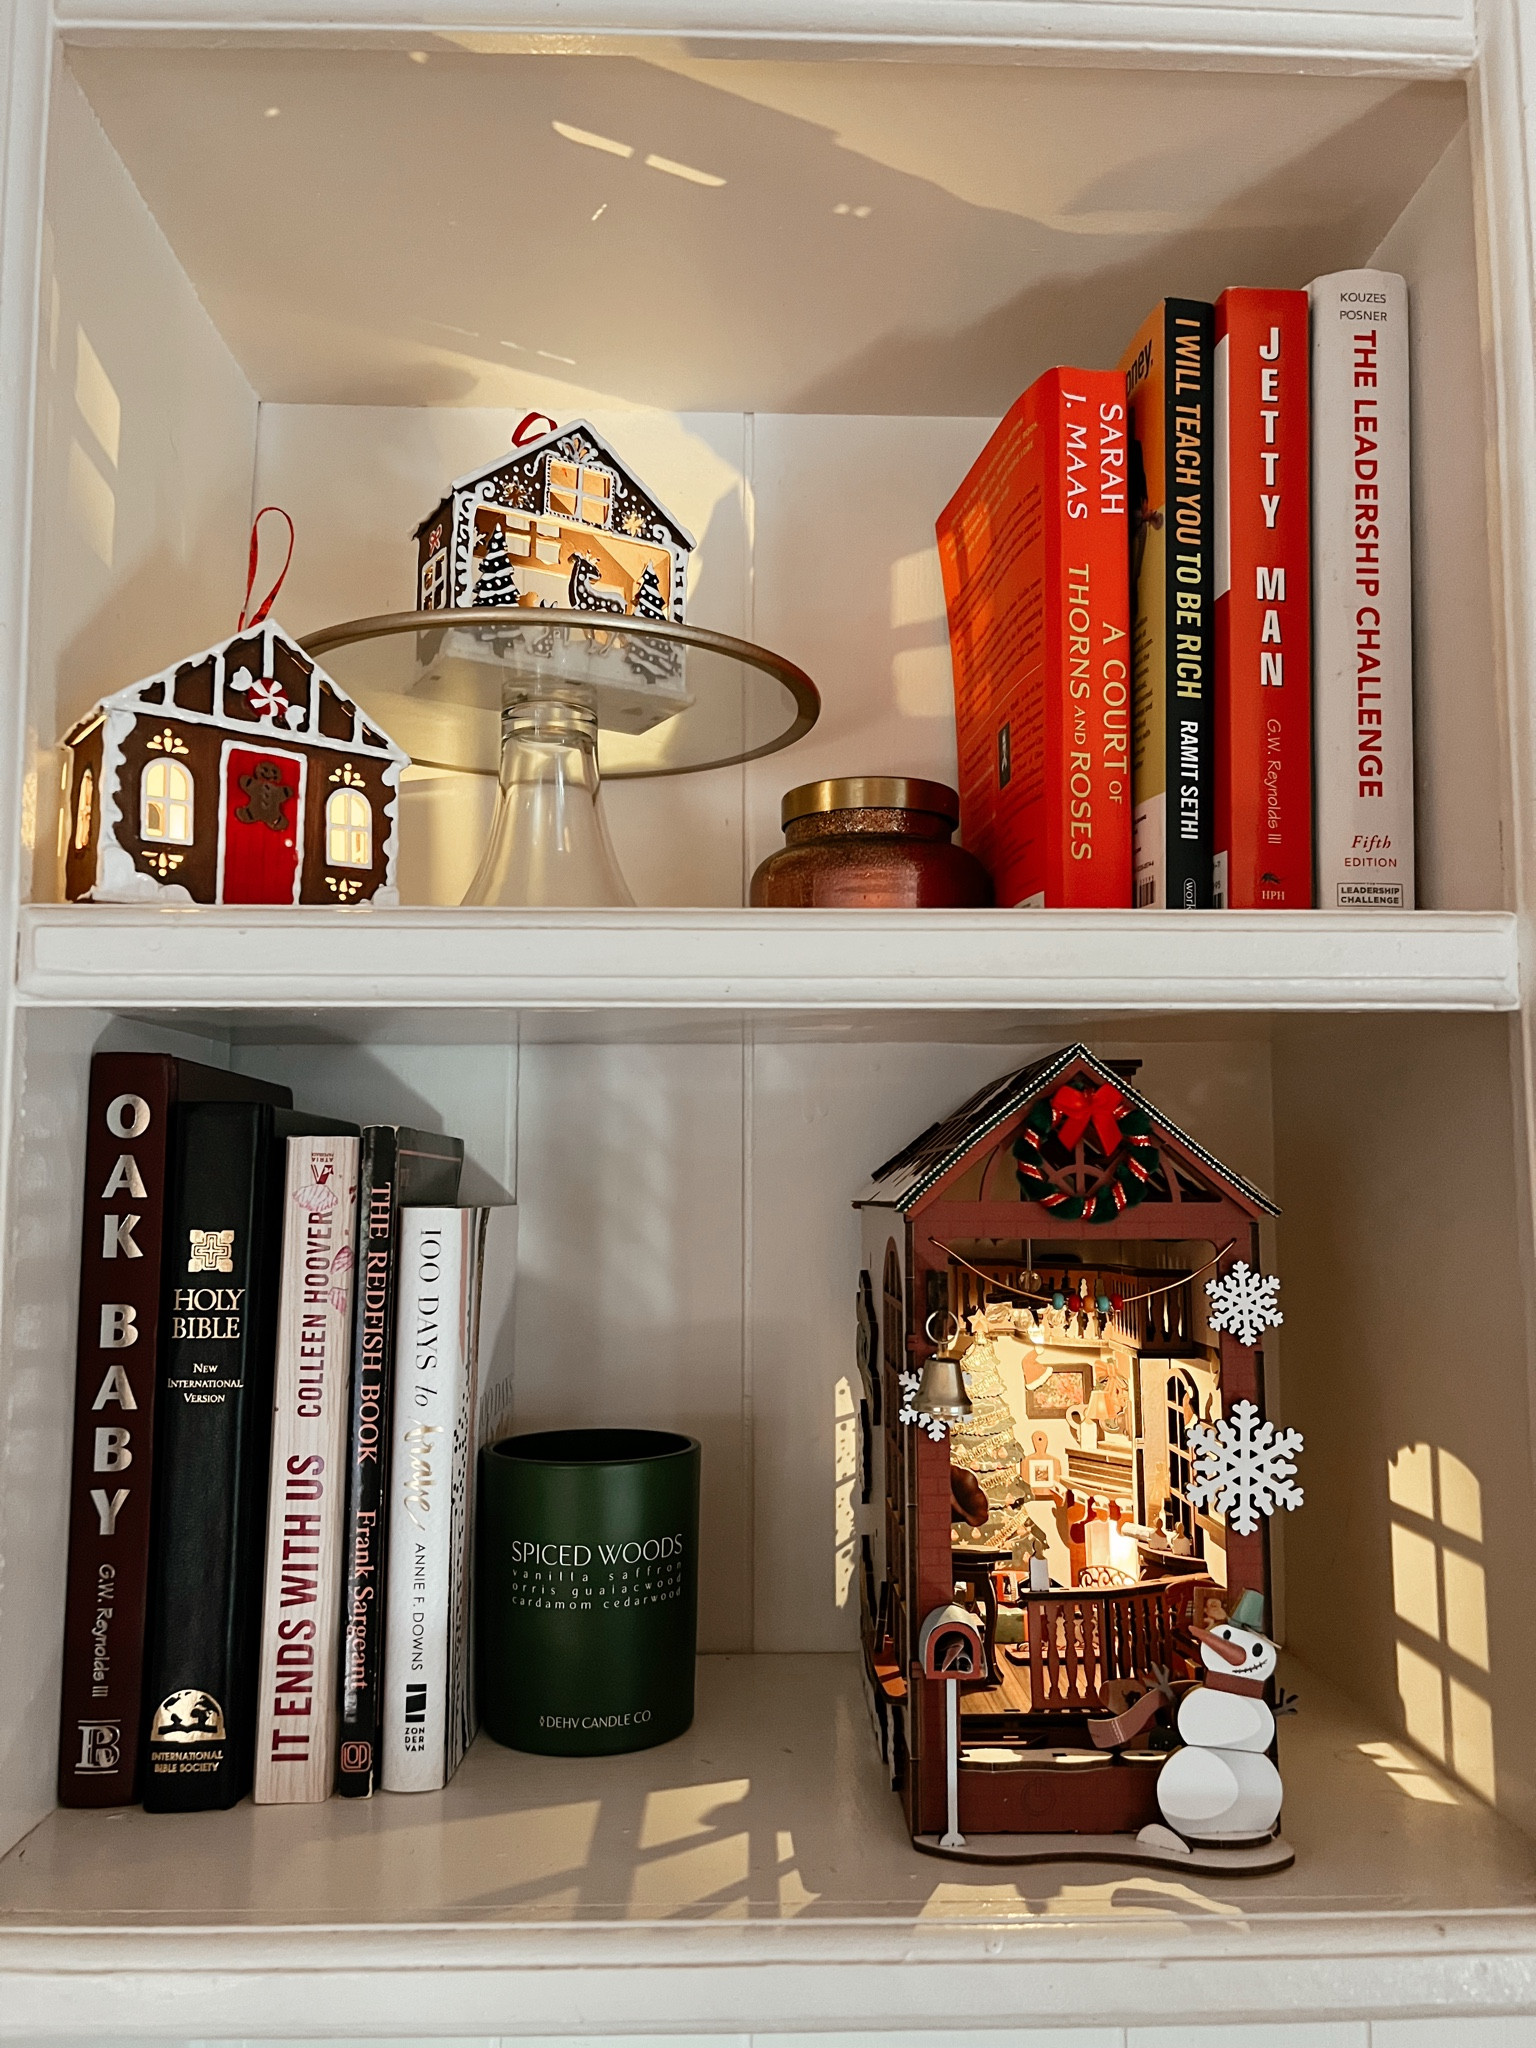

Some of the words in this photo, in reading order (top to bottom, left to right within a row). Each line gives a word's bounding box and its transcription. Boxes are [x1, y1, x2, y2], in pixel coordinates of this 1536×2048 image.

[1339, 310, 1388, 322] POSNER
[1340, 292, 1387, 304] KOUZES
[1175, 318, 1201, 328] I
[1175, 335, 1201, 395] WILL
[1353, 329, 1377, 388] THE
[1061, 389, 1088, 409] J.
[1175, 404, 1201, 485] TEACH
[1259, 326, 1281, 529] JETTY
[1066, 422, 1088, 519] MAAS
[1099, 403, 1125, 514] SARAH
[1175, 493, 1202, 545] YOU
[1354, 399, 1380, 598] LEADERSHIP
[1176, 553, 1202, 584] TO
[1068, 563, 1091, 699] THORNS
[1176, 591, 1202, 627] BE
[1256, 566, 1285, 688] MAN
[1102, 621, 1127, 645] A
[1176, 634, 1203, 699] RICH
[1073, 705, 1086, 745] AND
[1103, 659, 1127, 775] COURT
[1356, 606, 1383, 798] CHALLENGE
[1180, 720, 1199, 781] RAMIT
[1266, 718, 1281, 755] G.W.
[1070, 751, 1092, 860] ROSES
[1108, 780, 1122, 804] OF
[1180, 785, 1199, 840] SETHI
[1263, 760, 1282, 829] Reynolds
[1267, 833, 1282, 844] III
[1351, 834, 1392, 853] Fifth
[1344, 857, 1398, 868] EDITION
[1261, 890, 1286, 901] HPH
[1340, 886, 1400, 896] LEADERSHIP
[1340, 896, 1400, 905] CHALLENGE
[101, 1093, 151, 1259] OAK
[370, 1182, 392, 1240] THE
[304, 1211, 333, 1304] HOOVER
[173, 1288, 246, 1311] HOLY
[361, 1250, 388, 1372] REDFISH
[171, 1316, 241, 1339] BIBLE
[415, 1295, 440, 1371] DAYS
[297, 1314, 327, 1418] COLLEEN
[90, 1303, 138, 1536] BABY
[414, 1385, 438, 1408] to
[357, 1382, 381, 1464] BOOK
[286, 1454, 325, 1501] US
[280, 1514, 322, 1608] WITH
[354, 1509, 377, 1580] Frank
[412, 1543, 426, 1590] ANNIE
[511, 1540, 592, 1567] SPICED
[597, 1533, 683, 1566] WOODS
[97, 1563, 117, 1603] G.W.
[512, 1568, 589, 1582] vanilla
[608, 1561, 682, 1581] saffron
[512, 1583, 556, 1596] orris
[412, 1597, 424, 1608] F.
[511, 1596, 592, 1610] cardamom
[603, 1586, 681, 1609] cedarwood
[91, 1608, 114, 1682] Reynolds
[347, 1586, 374, 1690] Sargeant
[411, 1613, 424, 1671] DOWNS
[274, 1619, 317, 1716] ENDS
[405, 1727, 425, 1735] ZON
[405, 1736, 425, 1744] DER
[581, 1713, 631, 1729] CANDLE
[633, 1709, 652, 1724] CO
[151, 1750, 224, 1762] INTERNATIONAL
[154, 1763, 177, 1774] BIBLE
[179, 1762, 220, 1774] SOCIETY
[271, 1728, 310, 1762] IT
[405, 1744, 425, 1752] VAN
